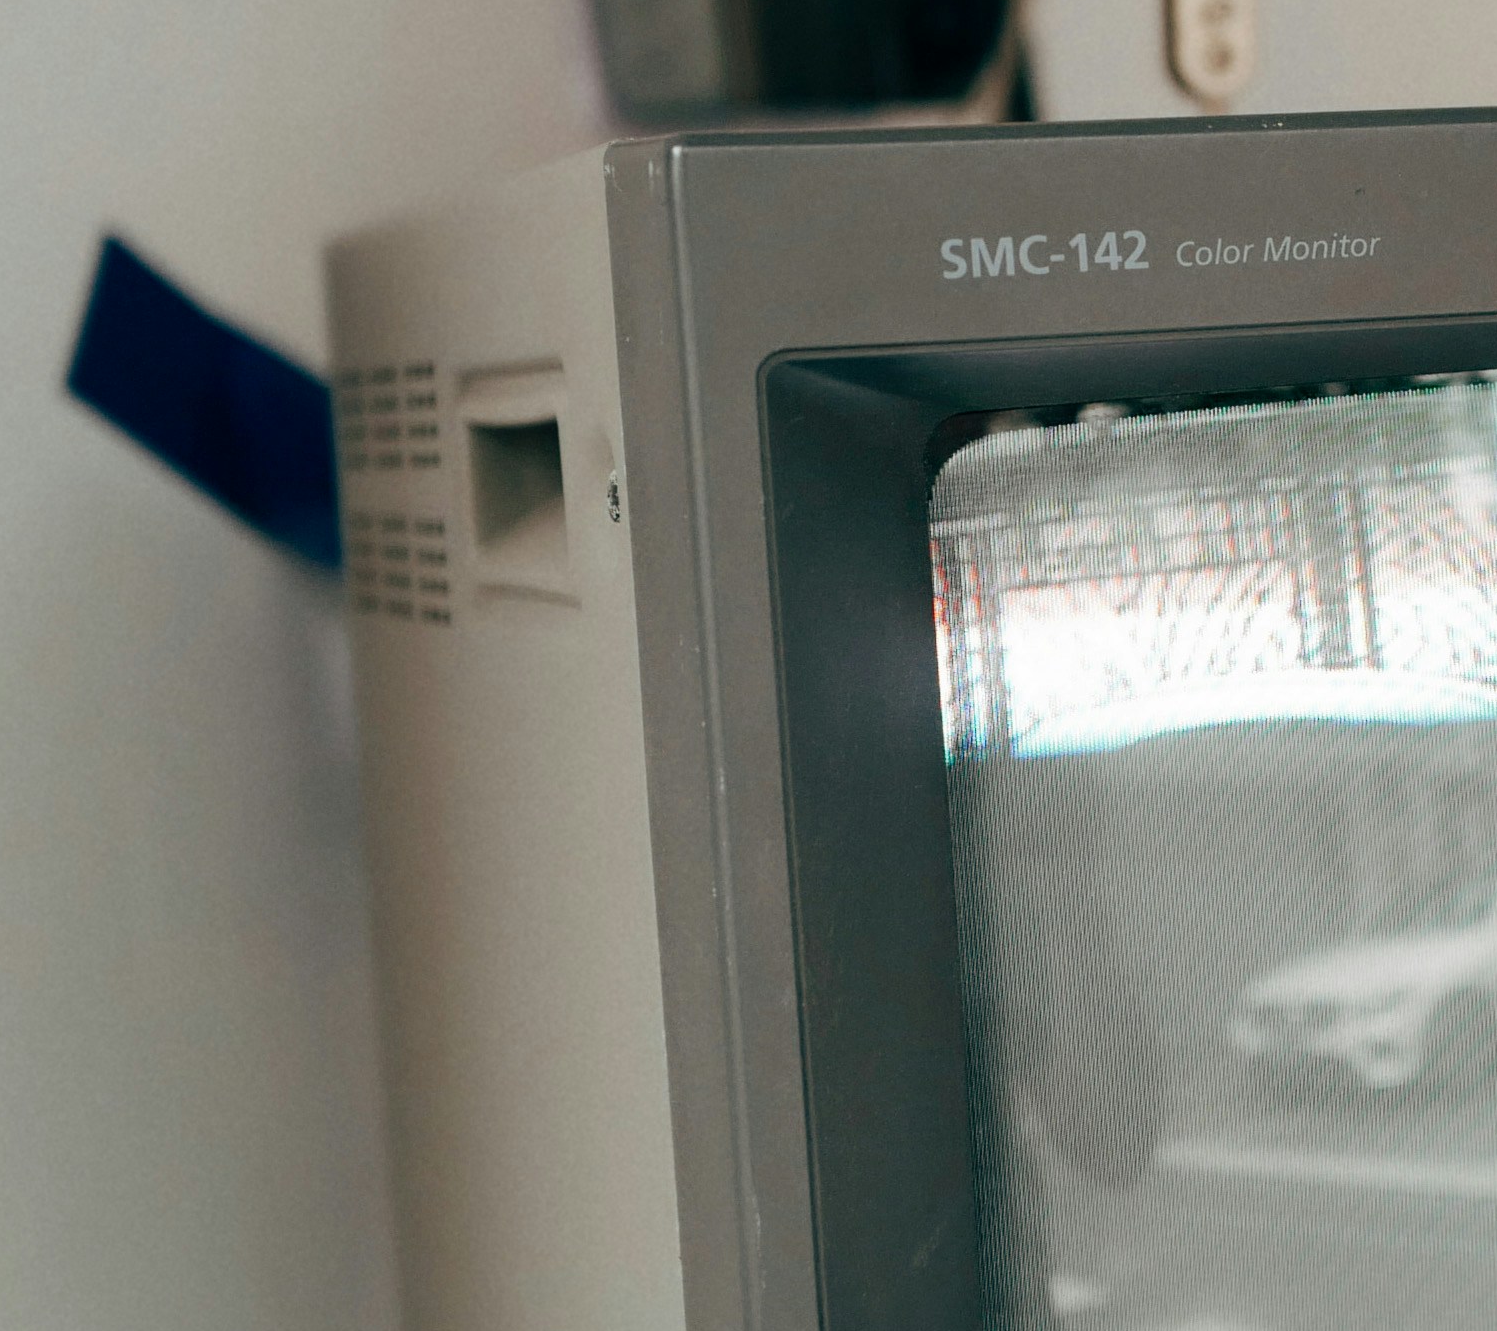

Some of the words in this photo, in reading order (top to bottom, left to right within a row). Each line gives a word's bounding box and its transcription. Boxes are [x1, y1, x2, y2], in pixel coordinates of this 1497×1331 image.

[939, 230, 1151, 281] SMC-142
[1175, 237, 1255, 269] Color
[1262, 231, 1381, 264] Monitor
